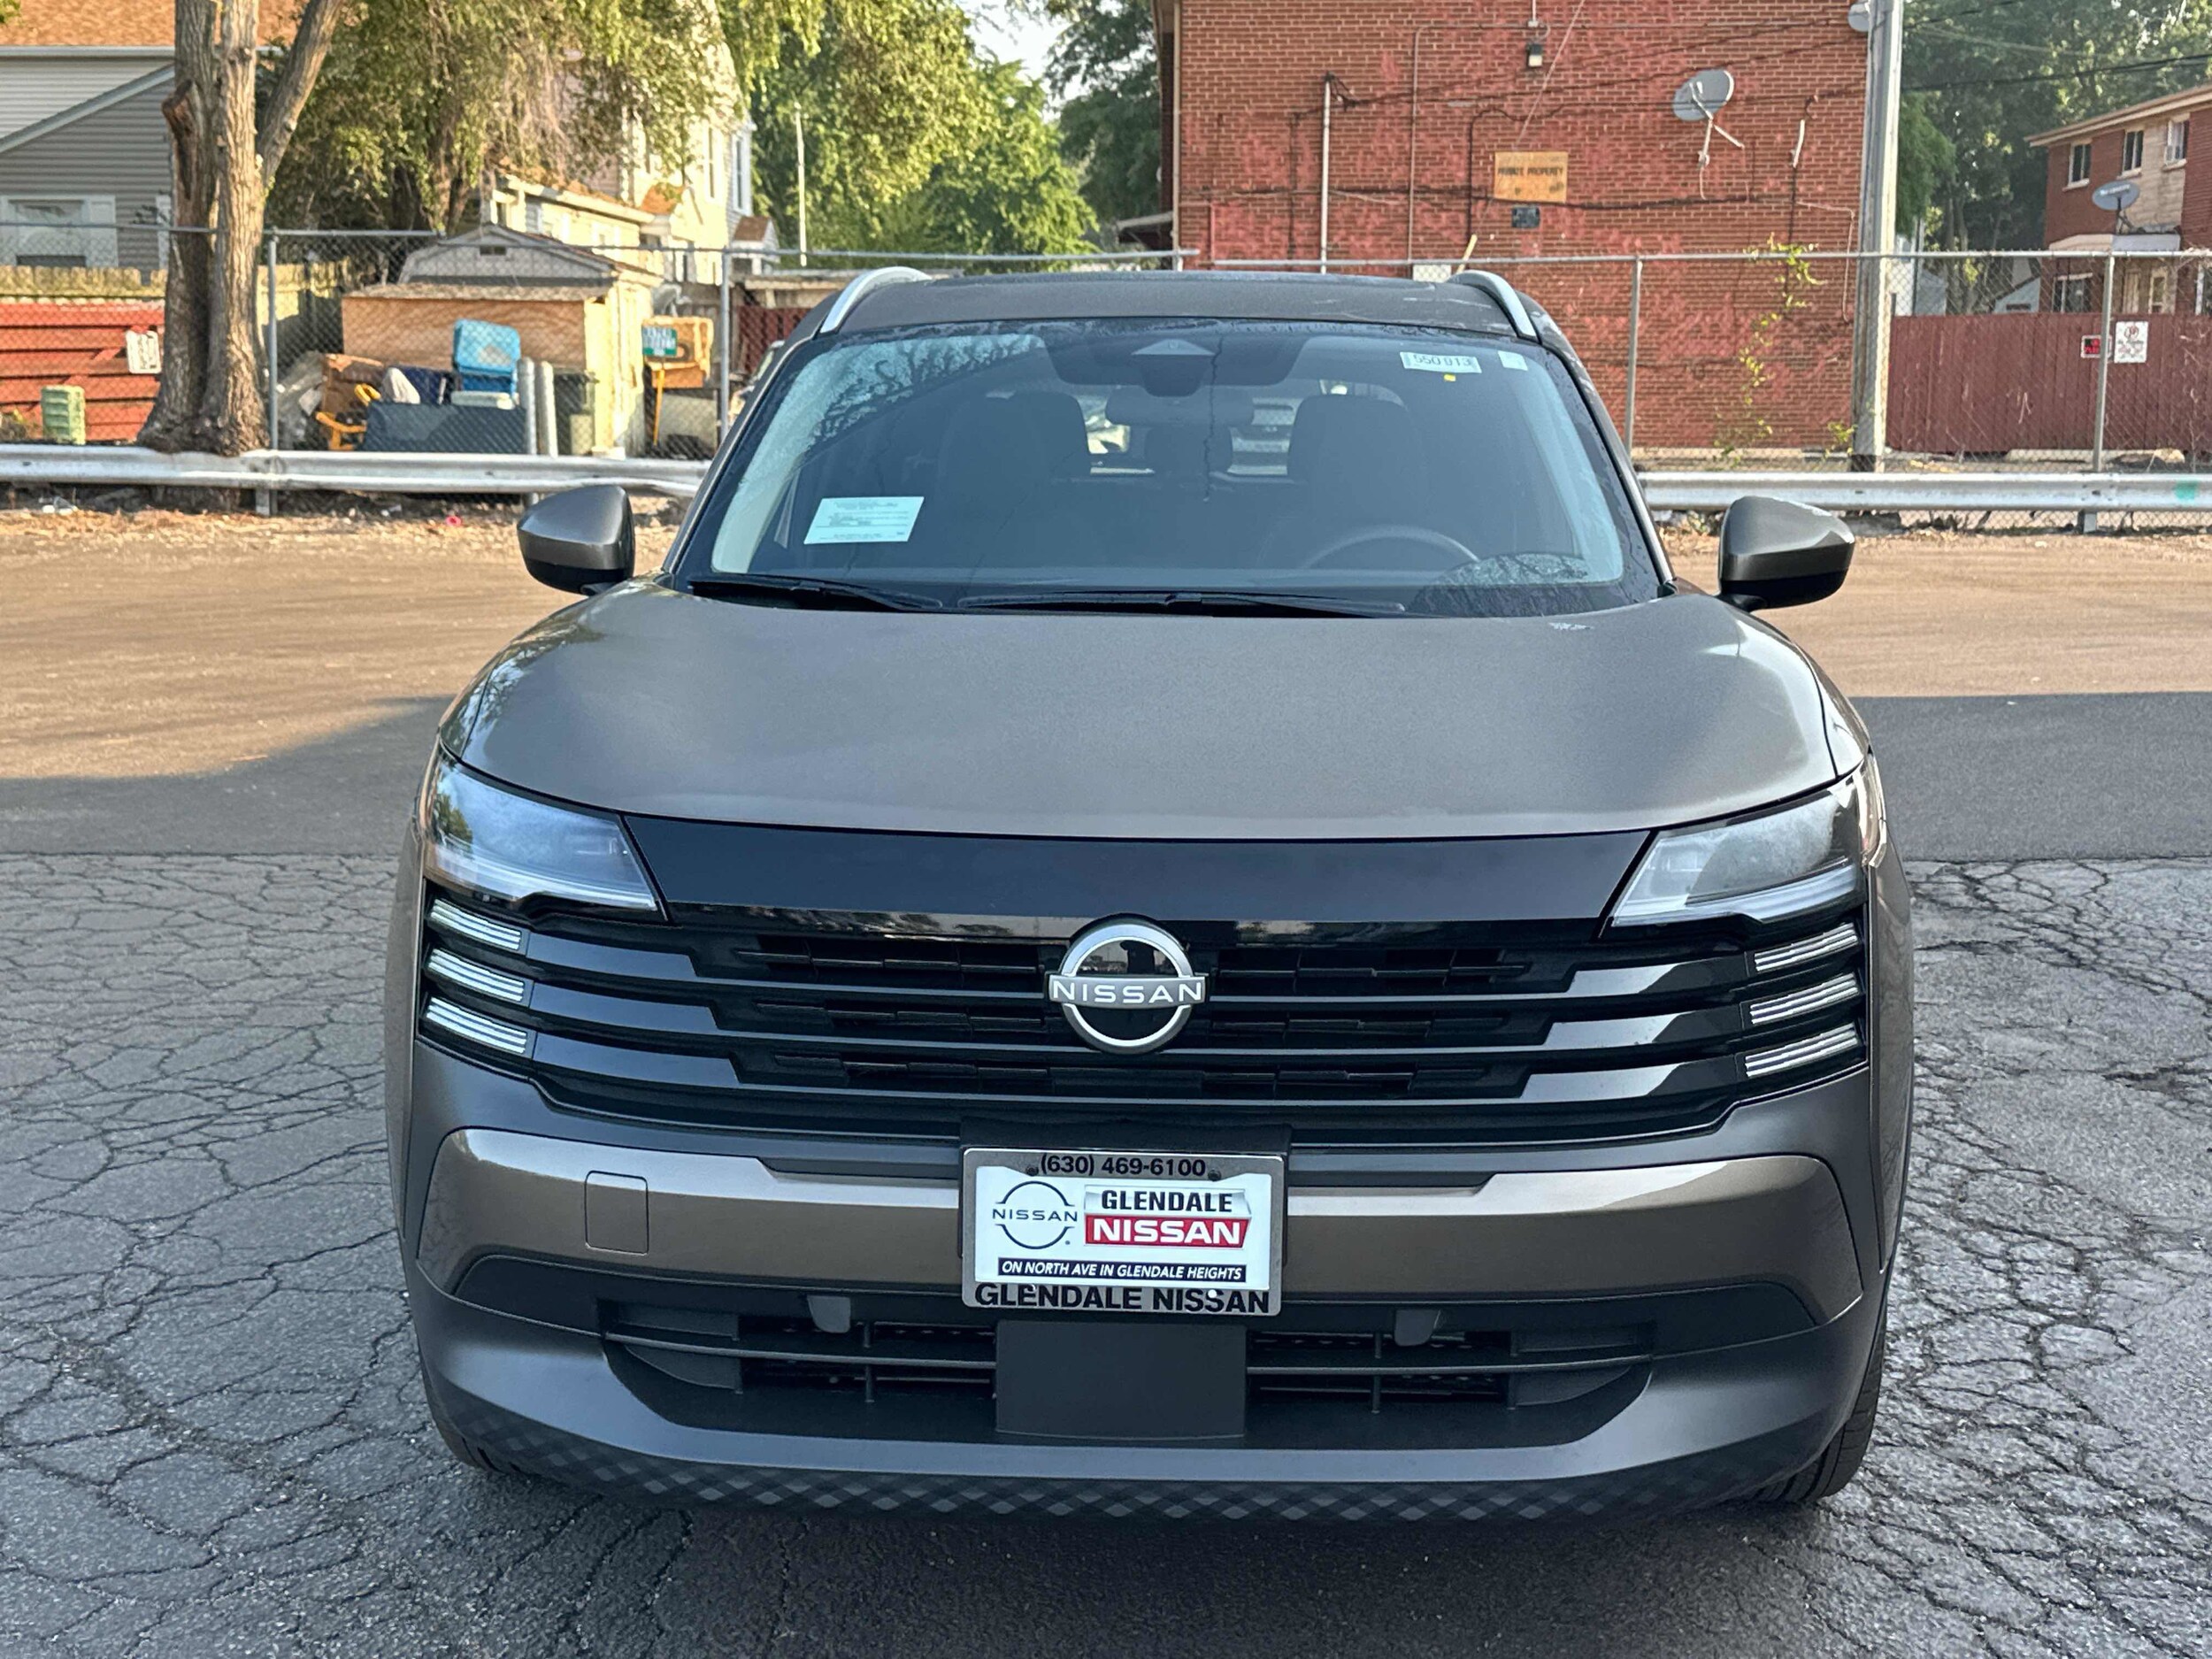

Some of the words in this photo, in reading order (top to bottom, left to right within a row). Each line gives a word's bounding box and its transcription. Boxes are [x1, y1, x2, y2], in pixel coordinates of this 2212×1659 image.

[1053, 980, 1202, 1003] NISSAN
[1041, 1153, 1095, 1176] (630)
[1102, 1157, 1206, 1177] 469-6100
[1101, 1189, 1233, 1212] GLENDALE
[992, 1209, 1078, 1223] NISSAN
[1093, 1218, 1240, 1246] NISSAN
[1002, 1261, 1023, 1274] ON
[1024, 1262, 1070, 1276] NORTH
[1071, 1263, 1097, 1277] AVE
[1099, 1265, 1115, 1278] IN
[1117, 1265, 1184, 1279] GLENDALE
[1187, 1267, 1242, 1281] HEIGHTS
[974, 1283, 1142, 1310] GLENDALE
[1152, 1287, 1270, 1314] NISSAN
